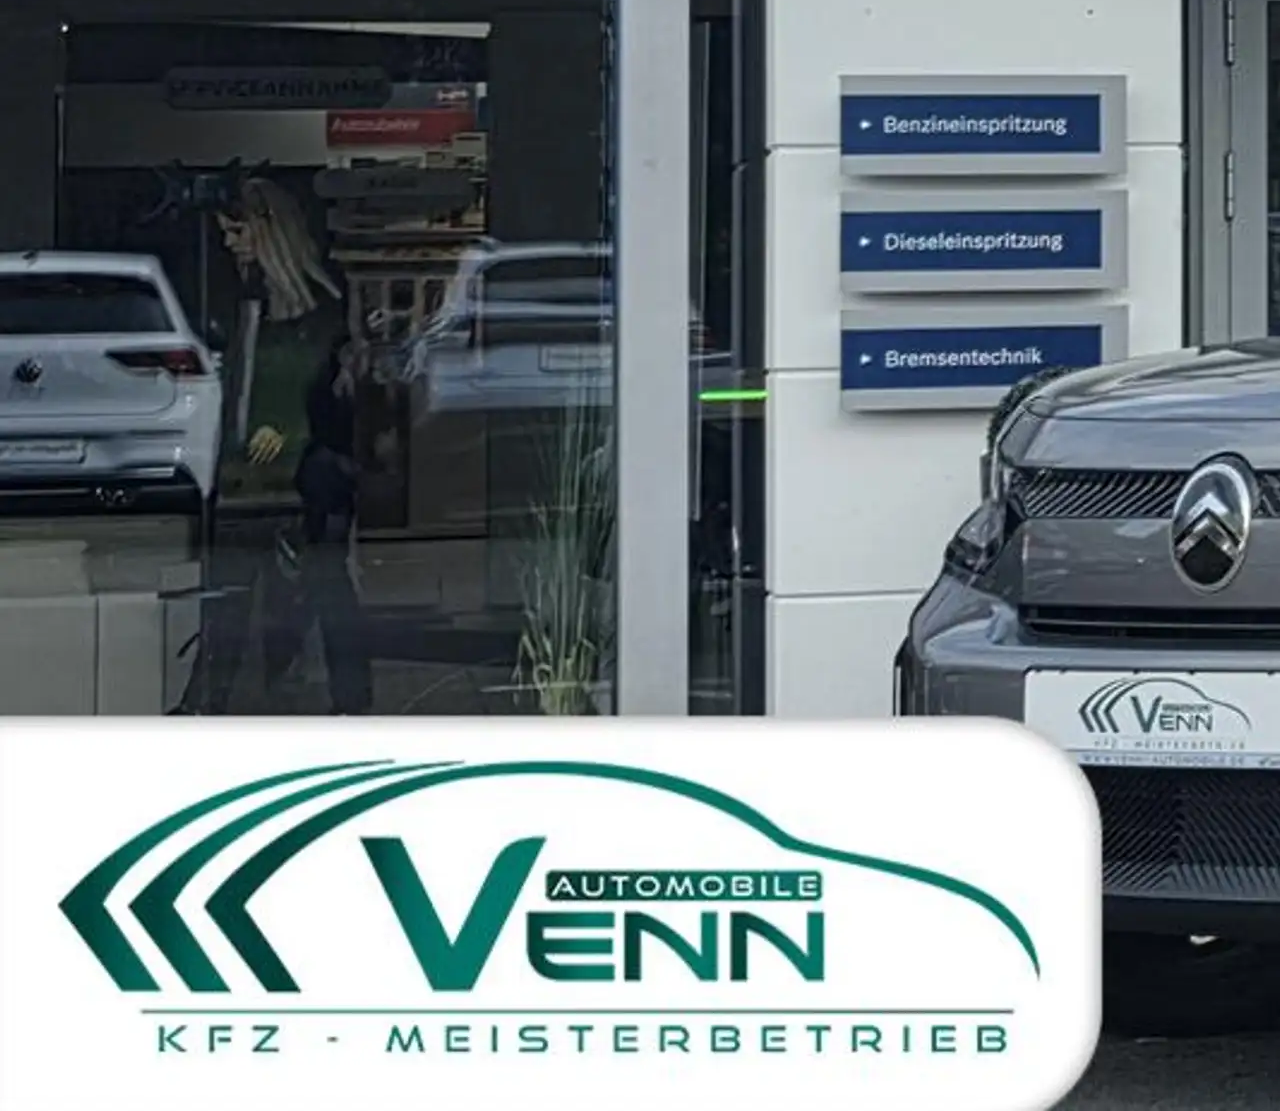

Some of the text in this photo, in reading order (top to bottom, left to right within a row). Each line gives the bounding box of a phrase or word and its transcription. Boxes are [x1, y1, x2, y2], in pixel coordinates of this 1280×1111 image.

[883, 114, 1068, 136] Benzineinspritzung
[884, 230, 1064, 253] Dieseleinspritzung
[884, 347, 1043, 369] Bremsentechnik
[1130, 696, 1213, 733] VENN
